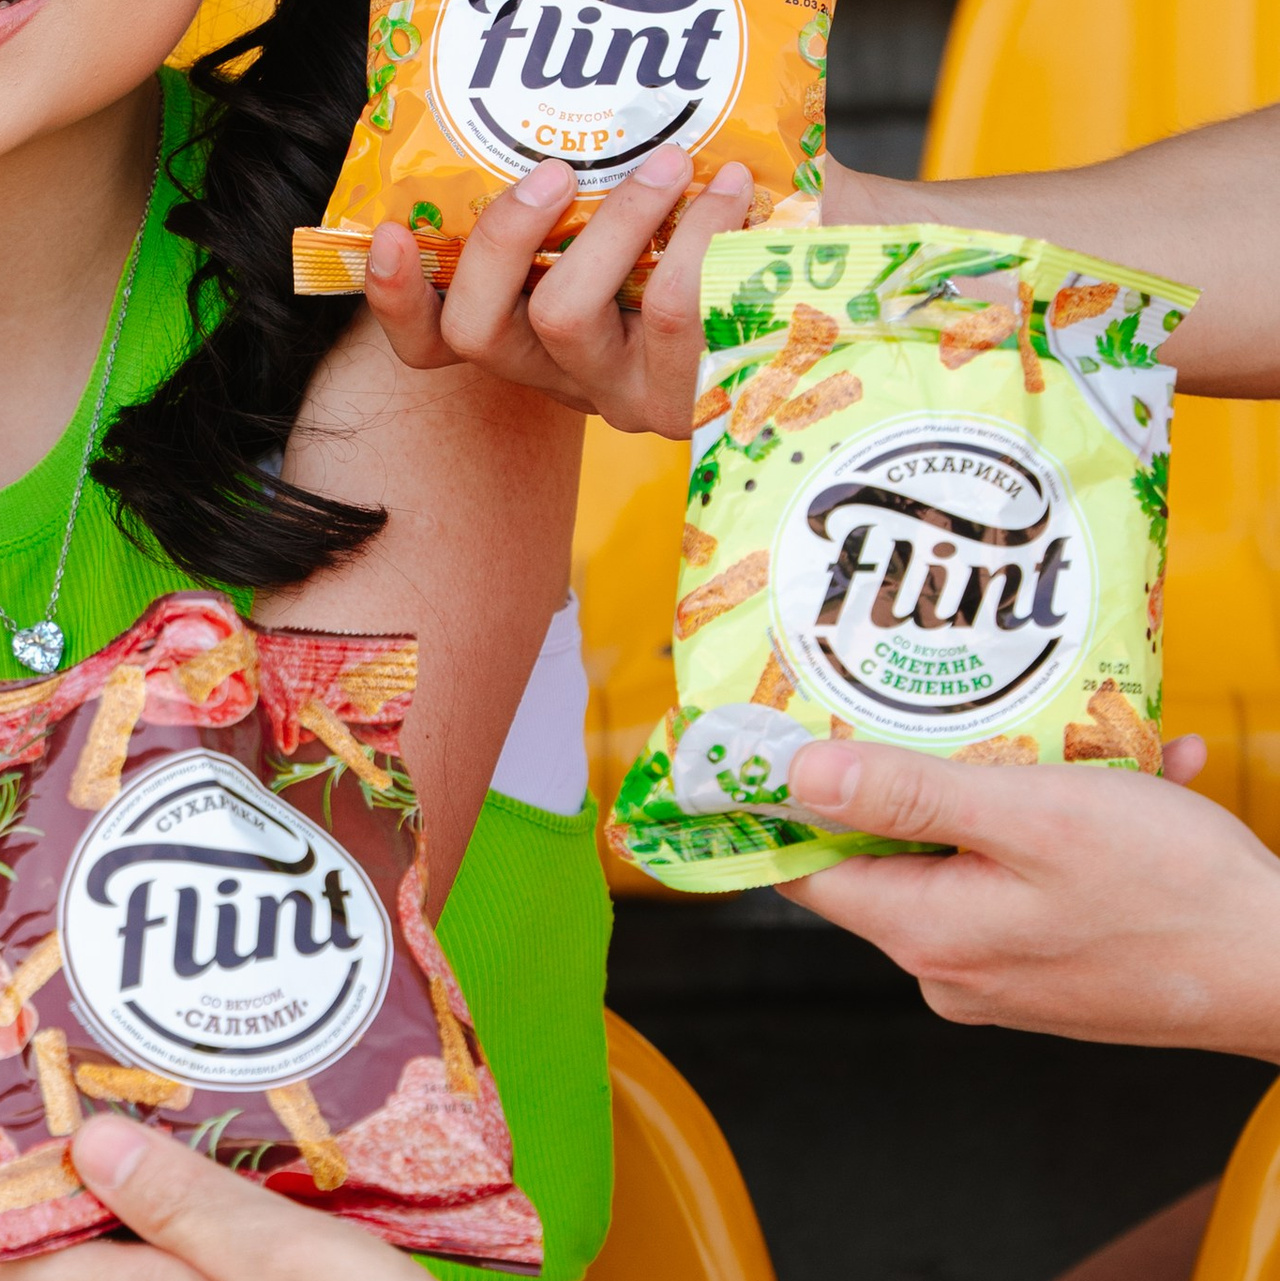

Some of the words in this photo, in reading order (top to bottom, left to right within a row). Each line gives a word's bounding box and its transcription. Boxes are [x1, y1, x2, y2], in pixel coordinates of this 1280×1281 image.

[538, 102, 555, 117] СО
[558, 108, 614, 123] ВКУСОМ
[535, 124, 610, 152] СЫР
[887, 456, 1023, 498] СУХАРИКИ
[875, 641, 985, 677] СМЕТАНА
[892, 635, 911, 649] СО
[913, 643, 969, 658] ВКУСОМ
[860, 658, 877, 675] С
[880, 669, 993, 696] ЗЕЛЕНЬЮ
[156, 795, 265, 833] СУХАРИКИ
[200, 994, 222, 1009] СО
[224, 987, 285, 1011] ВКУСОМ
[183, 999, 307, 1036] САЛЯМИ
